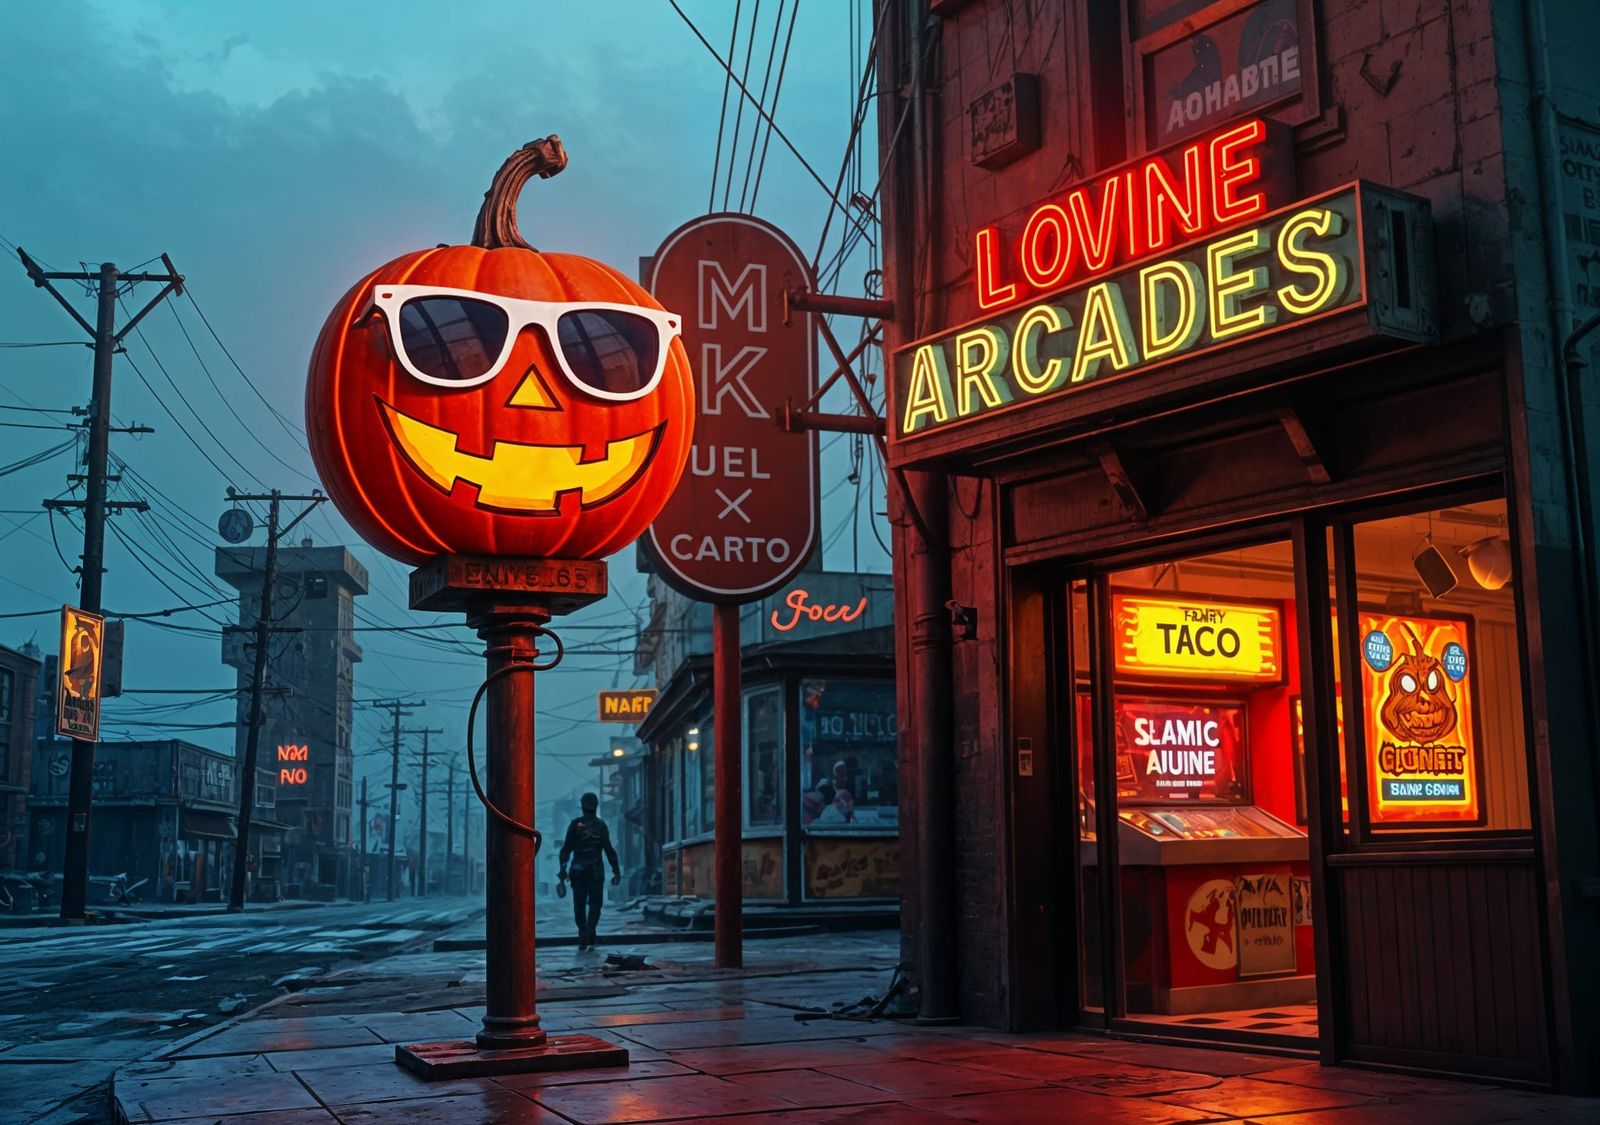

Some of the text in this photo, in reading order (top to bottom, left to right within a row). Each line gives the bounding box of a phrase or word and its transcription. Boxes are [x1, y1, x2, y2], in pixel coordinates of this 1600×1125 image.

[974, 118, 1267, 310] LOVINE
[903, 208, 1340, 434] ARCADES
[670, 533, 791, 564] CARTO
[1156, 622, 1241, 659] TACO
